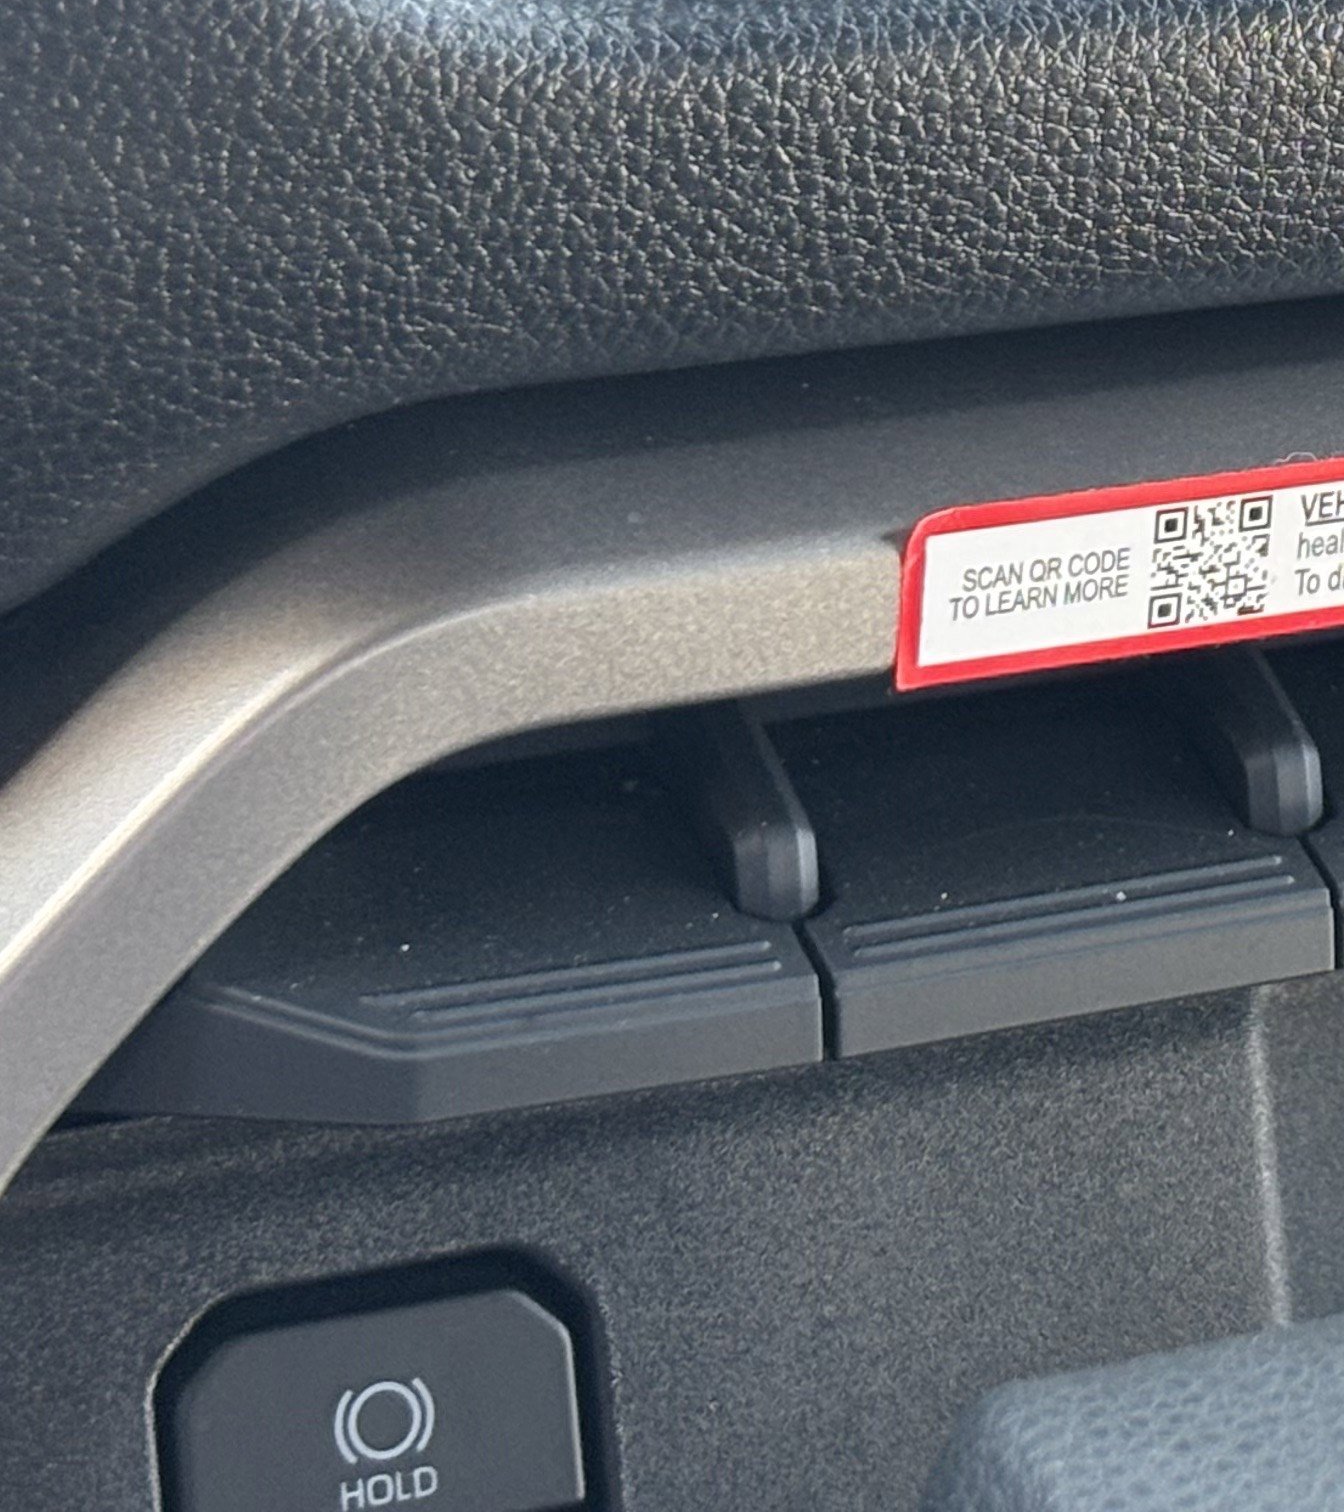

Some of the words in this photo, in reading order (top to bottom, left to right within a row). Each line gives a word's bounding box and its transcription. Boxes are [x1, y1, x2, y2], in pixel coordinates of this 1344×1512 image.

[962, 561, 1024, 592] SCAN
[1029, 557, 1063, 582] QR
[1067, 547, 1130, 578] CODE
[1295, 568, 1321, 596] To
[949, 595, 980, 622] TO
[984, 582, 1058, 617] LEARN
[1062, 573, 1129, 606] MORE
[340, 1465, 439, 1512] HOLD
